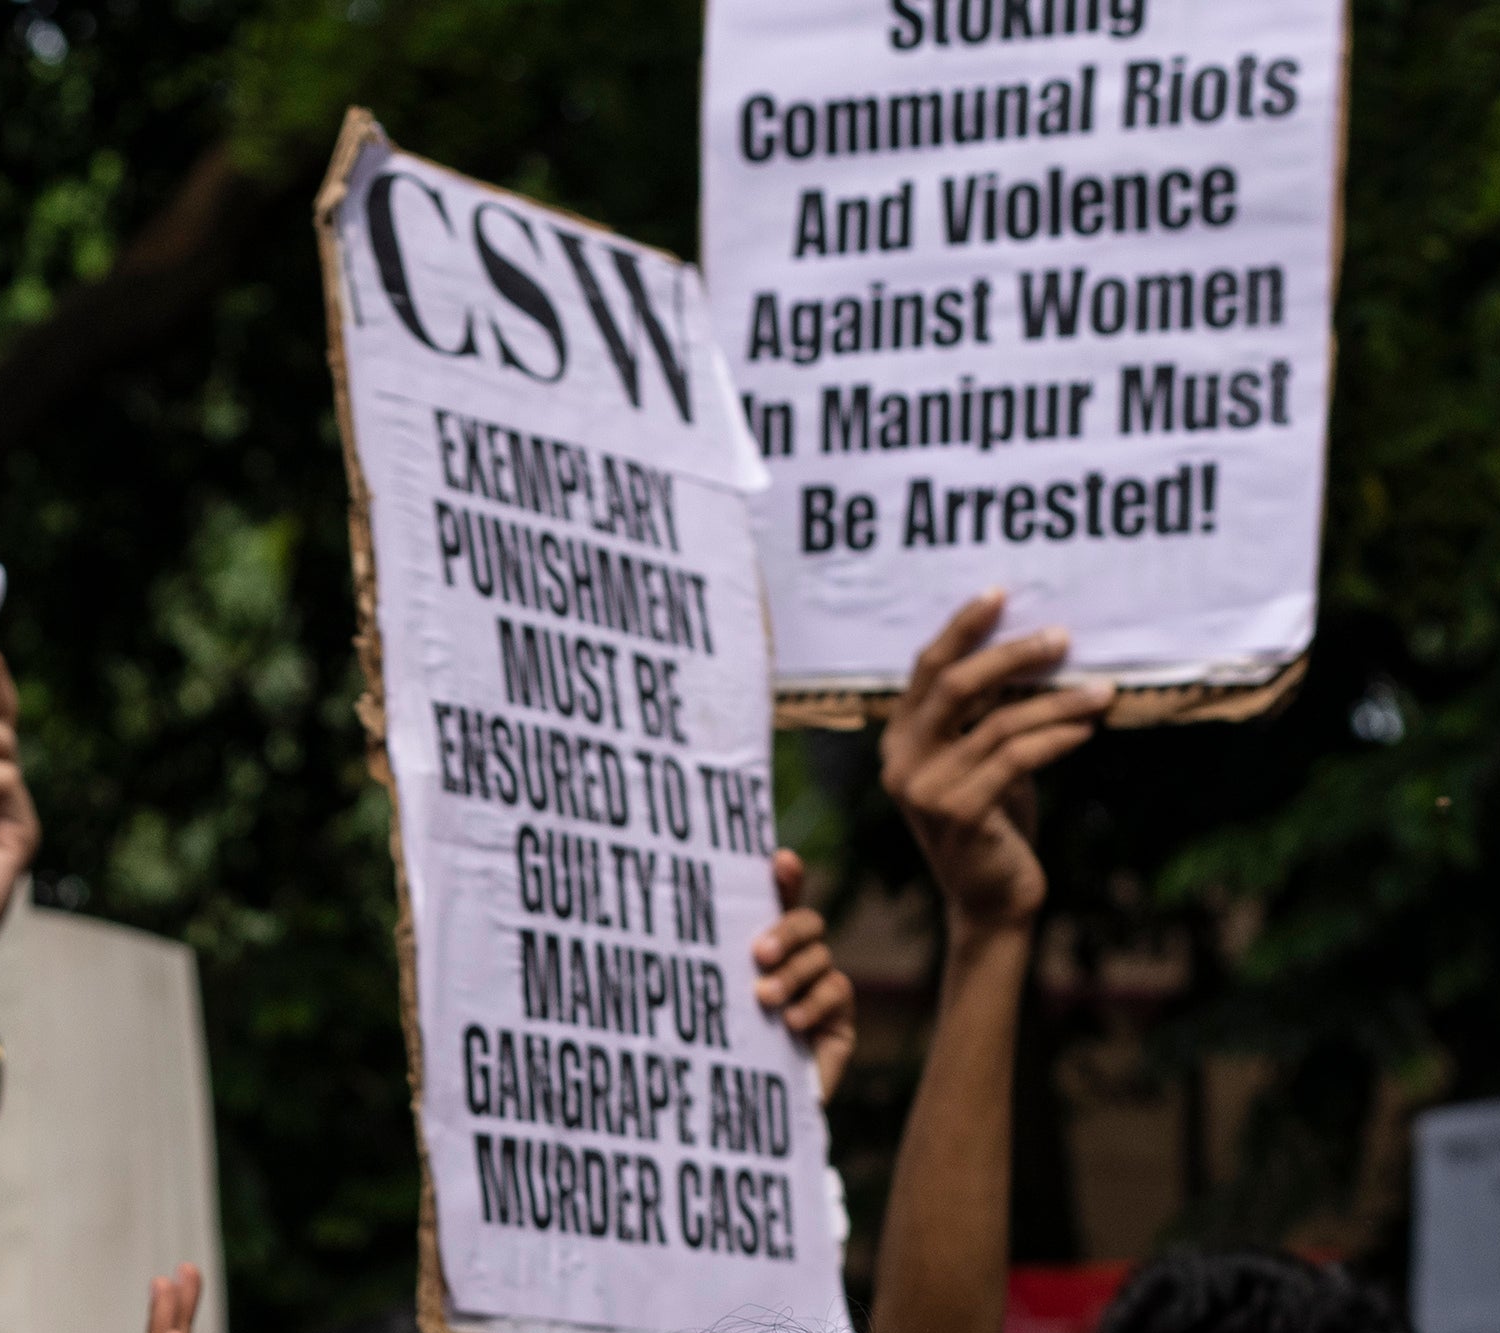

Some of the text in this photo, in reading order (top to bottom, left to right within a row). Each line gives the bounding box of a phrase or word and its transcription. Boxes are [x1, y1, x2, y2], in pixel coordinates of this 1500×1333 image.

[739, 52, 1300, 164] Communal Riots
[793, 162, 1239, 259] And Violence
[366, 170, 702, 425] CSW
[745, 263, 1287, 365] Against Women
[819, 376, 1093, 455] Manipur
[1118, 357, 1296, 437] Must
[434, 409, 682, 552] EXEMPLARY
[800, 463, 1219, 557] Be Arrested!
[434, 500, 715, 655] PUNISHMENT
[498, 618, 685, 745] MUST BE
[434, 703, 773, 858] ENSURED TO THE
[517, 828, 715, 945] GUILTY IN
[521, 932, 730, 1050] MANIPUR
[464, 1025, 790, 1160] GANGRAPE AND
[476, 1135, 795, 1262] MURDER CASE!
